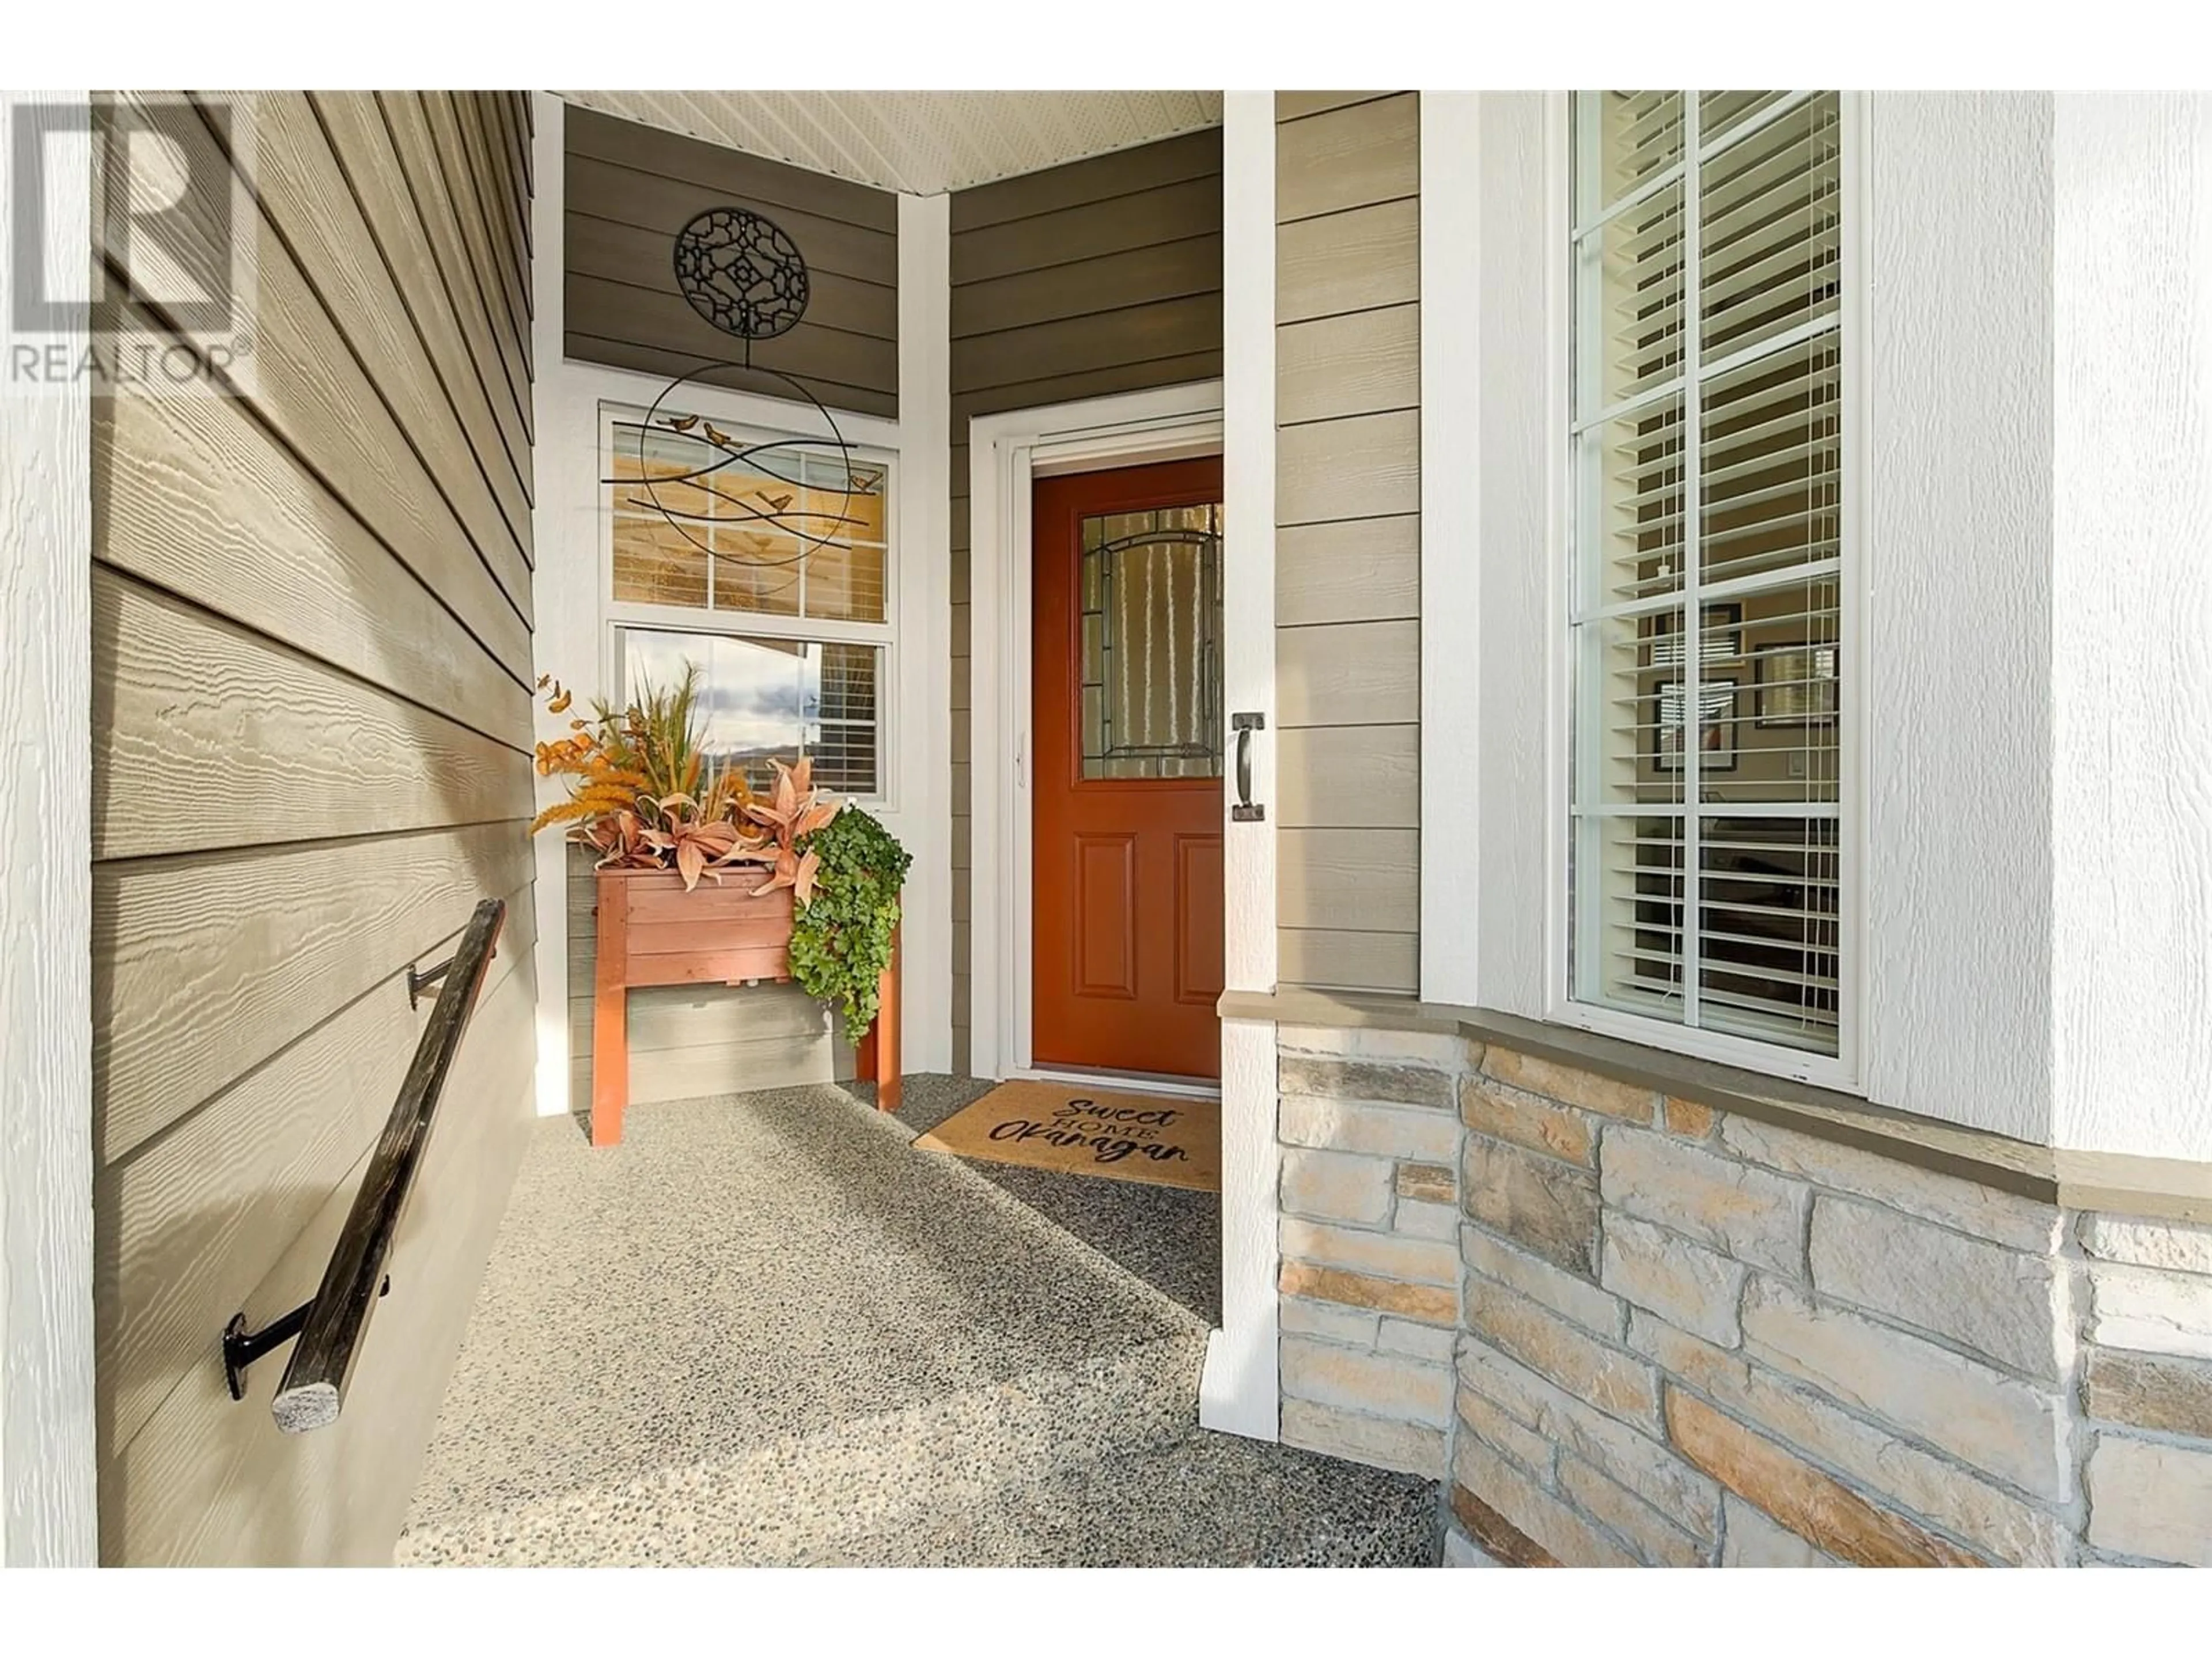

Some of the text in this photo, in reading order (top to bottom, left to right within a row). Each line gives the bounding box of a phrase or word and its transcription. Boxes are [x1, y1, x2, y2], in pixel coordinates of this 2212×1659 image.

[1052, 1099, 1184, 1127] Sweet
[989, 1119, 1189, 1163] Okanagan
[1051, 1118, 1160, 1140] HOME
